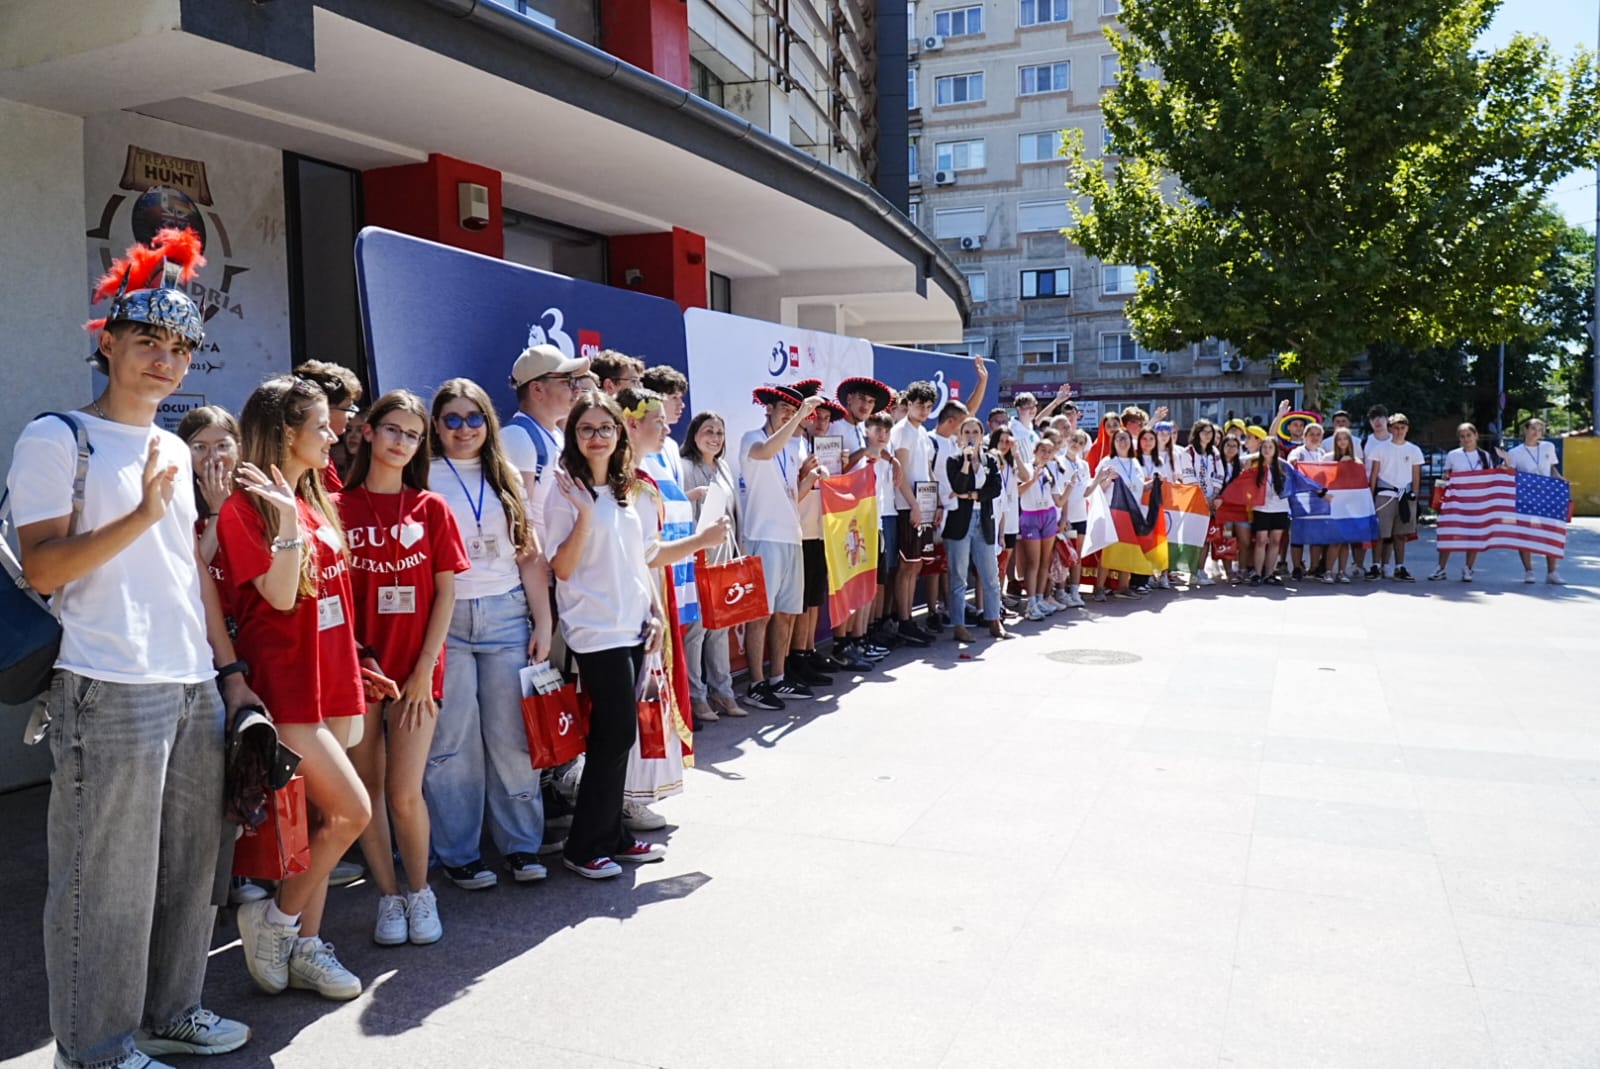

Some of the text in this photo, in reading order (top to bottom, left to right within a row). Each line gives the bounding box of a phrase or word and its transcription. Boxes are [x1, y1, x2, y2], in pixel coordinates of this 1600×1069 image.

[136, 149, 200, 174] TREASURE
[144, 165, 194, 187] HUNT
[347, 526, 387, 549] EU
[352, 551, 427, 573] LEXANDRIA
